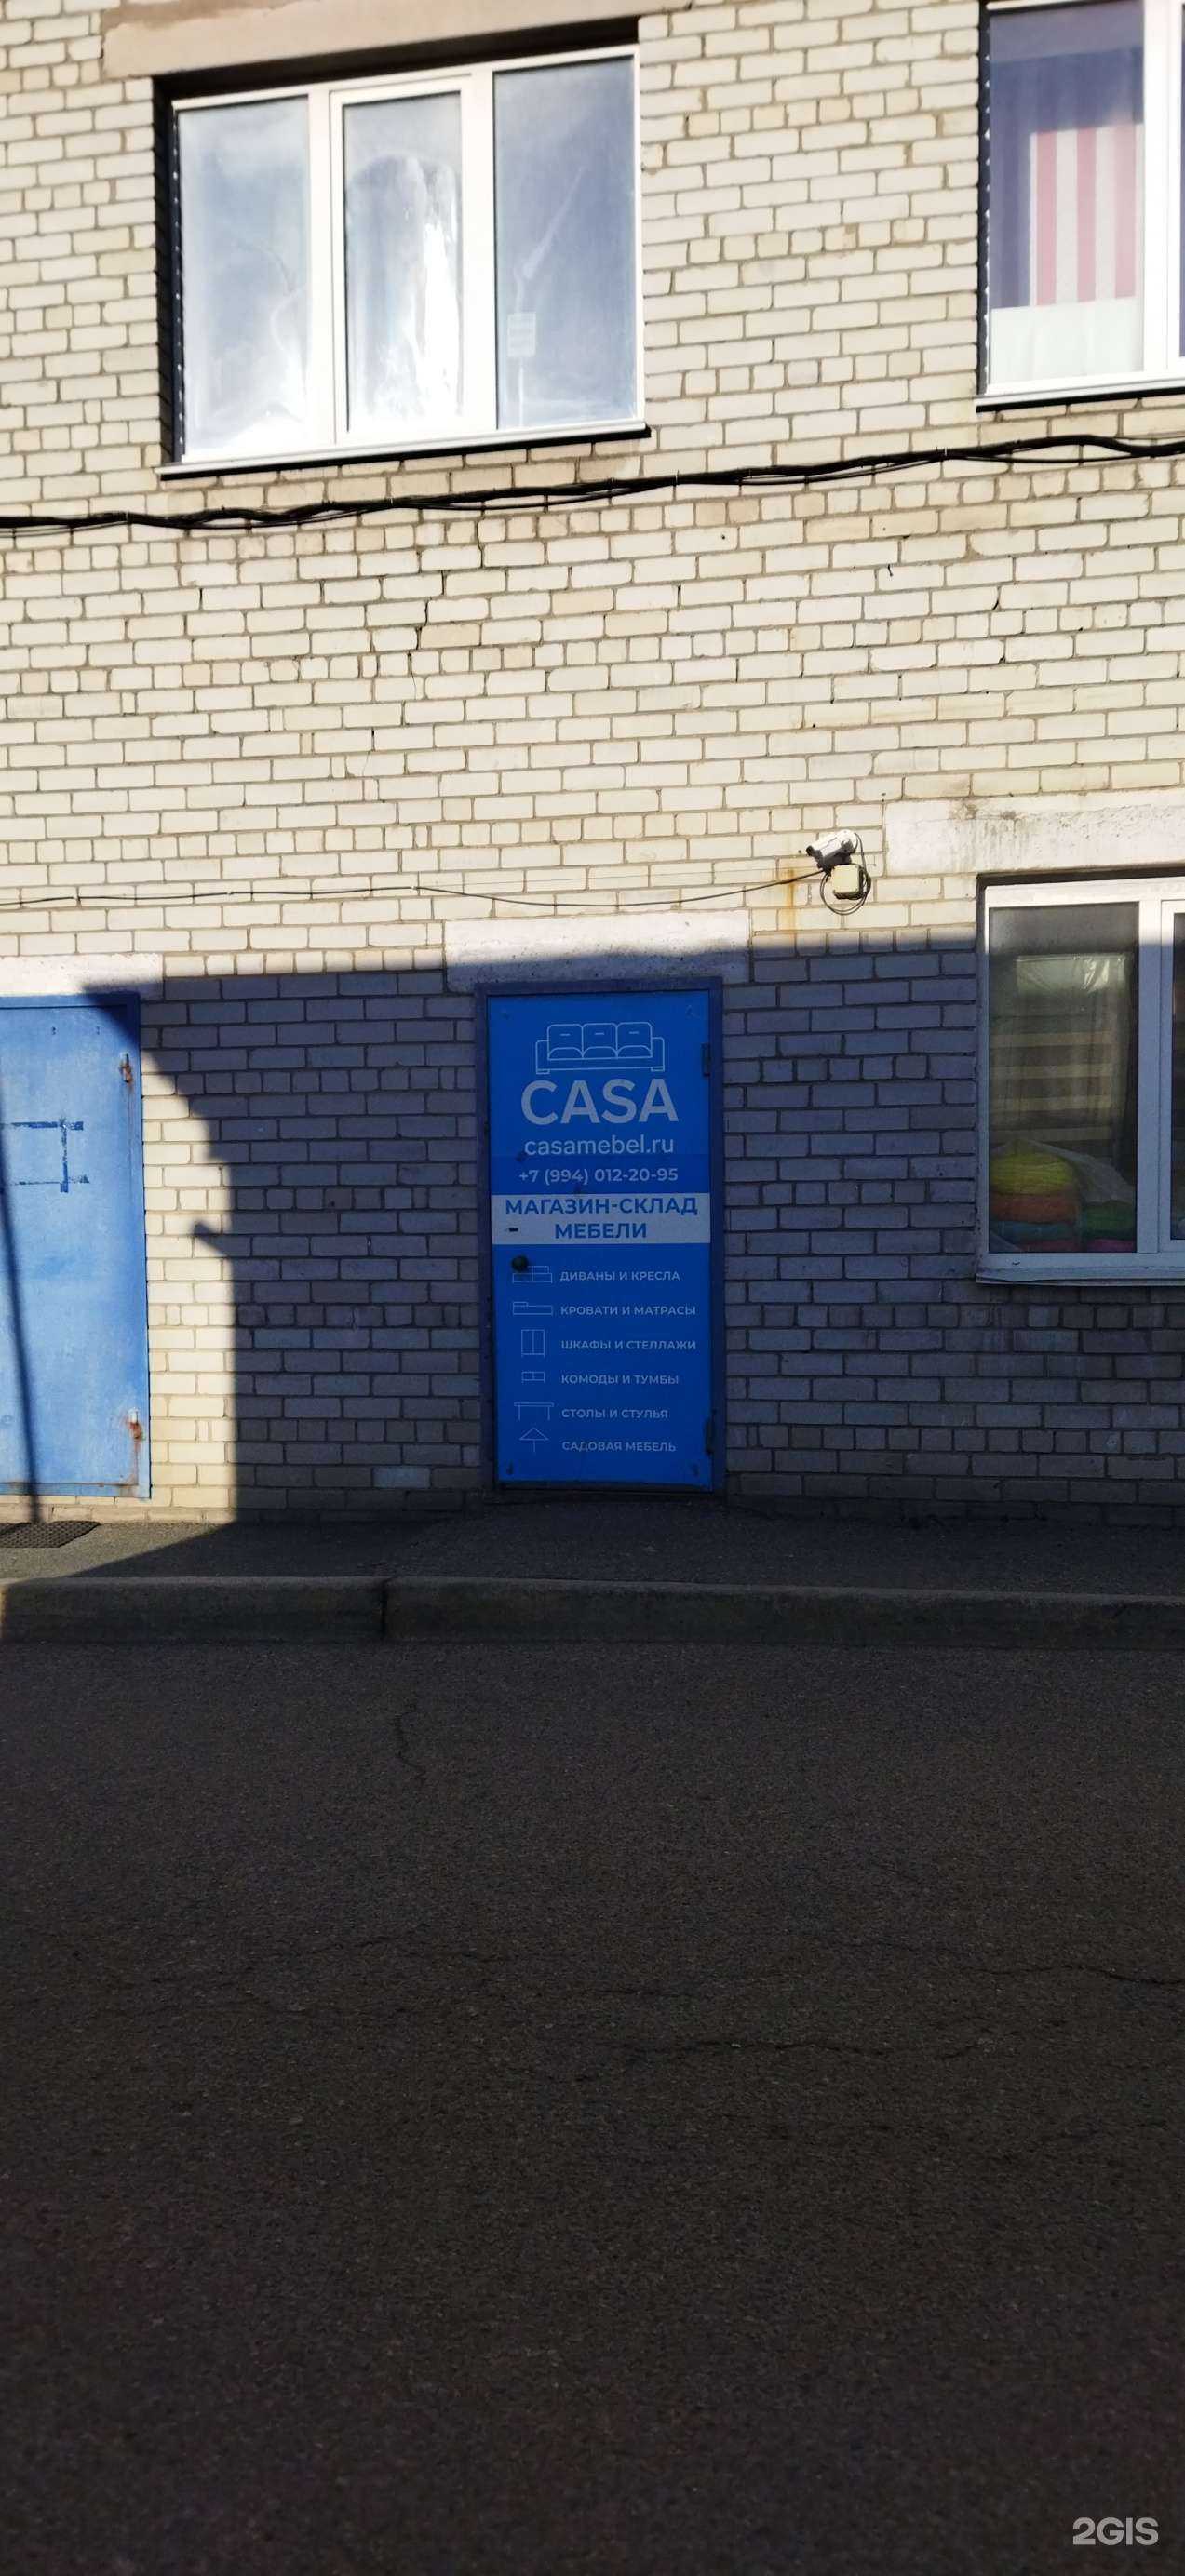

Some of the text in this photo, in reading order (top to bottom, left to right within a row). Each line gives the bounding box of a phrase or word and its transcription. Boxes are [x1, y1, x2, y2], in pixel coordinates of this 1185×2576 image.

[520, 1078, 680, 1126] CASA
[524, 1134, 675, 1156] casamebel.ru
[519, 1168, 679, 1186] +7 (994) 012-20-95
[505, 1197, 698, 1215] МАГАЗИН-СКЛАД
[555, 1223, 648, 1240] МЕБЕЛИ
[559, 1271, 680, 1282] ДИВАНЫ И КРЕСЛА
[560, 1306, 696, 1316] КРОВАТИ И МАТРАСЫ
[561, 1340, 696, 1350] ШКАФЫ И СТЕЛЛАЖИ
[561, 1375, 679, 1385] КОМОДЫ И ТУМБЫ
[561, 1409, 669, 1419] СТОЛЫ И СТУЛЬЯ
[561, 1442, 677, 1452] САДОВАЯ МЕБЕЛЬ
